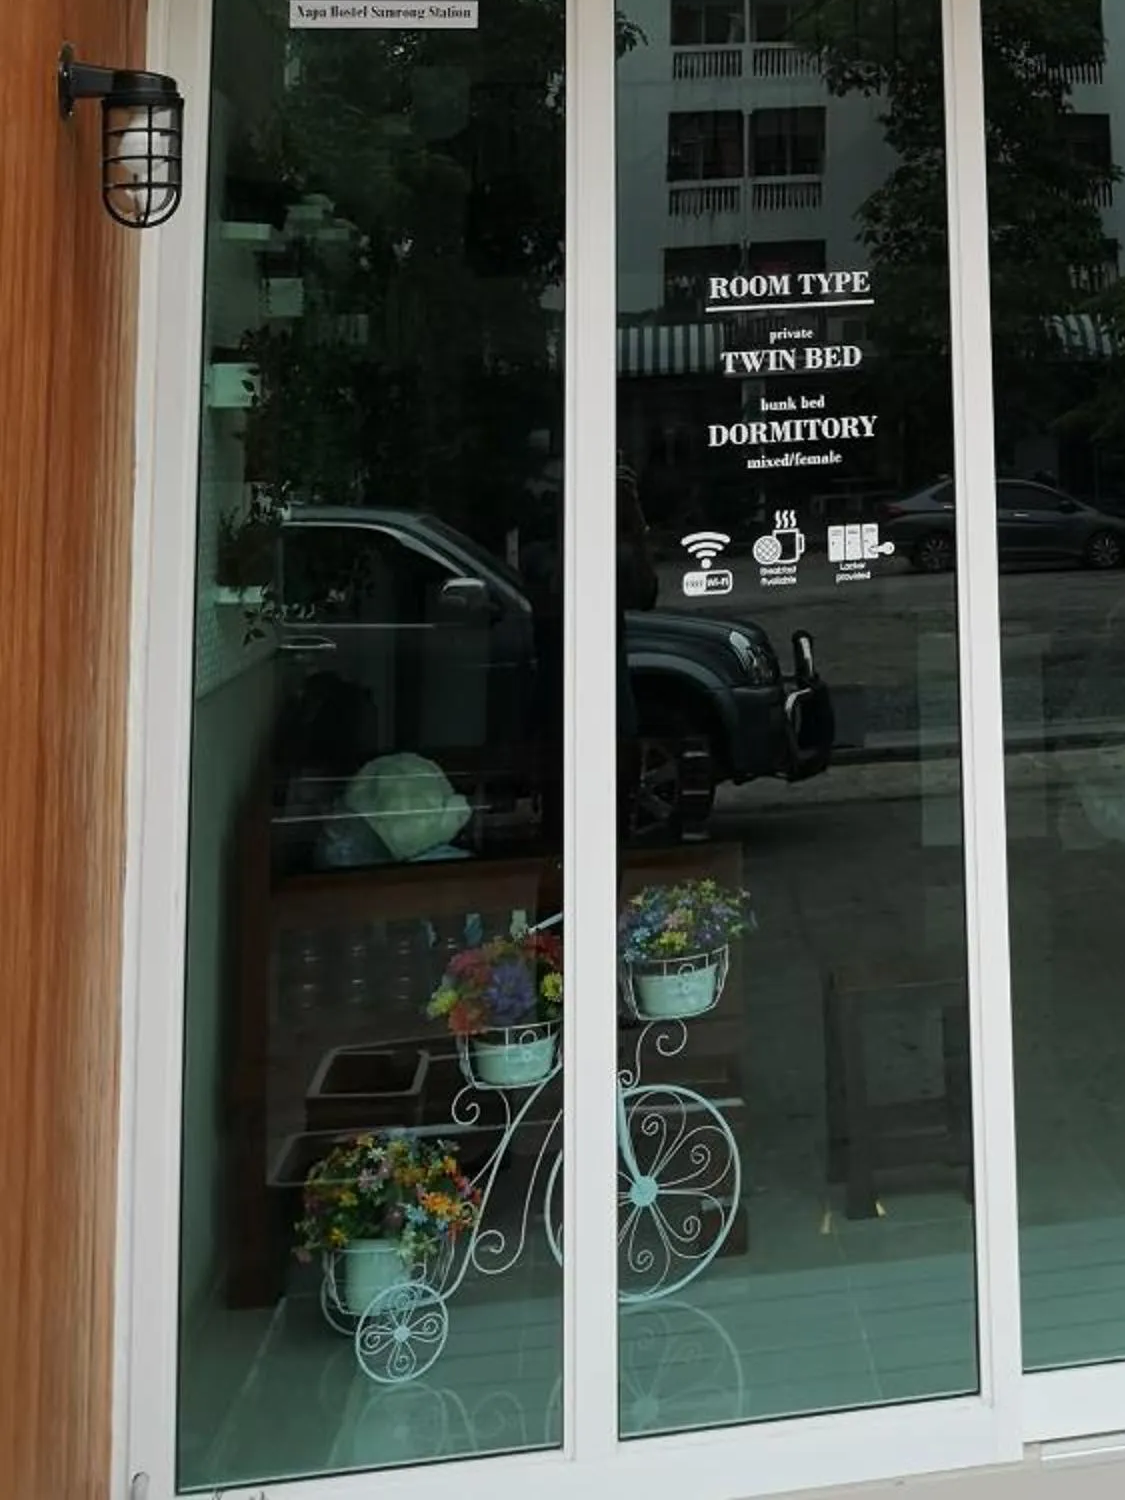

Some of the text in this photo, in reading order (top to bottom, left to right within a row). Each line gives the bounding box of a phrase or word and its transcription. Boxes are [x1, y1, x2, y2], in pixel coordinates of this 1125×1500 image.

[297, 4, 472, 21] Napa Hostel Samrong Station
[708, 270, 872, 300] ROOM TYPE
[768, 326, 815, 345] private
[719, 345, 863, 376] TWIN BED
[760, 395, 826, 412] bunk bed
[707, 415, 878, 448] DORMITORY
[747, 450, 843, 470] mixed/female
